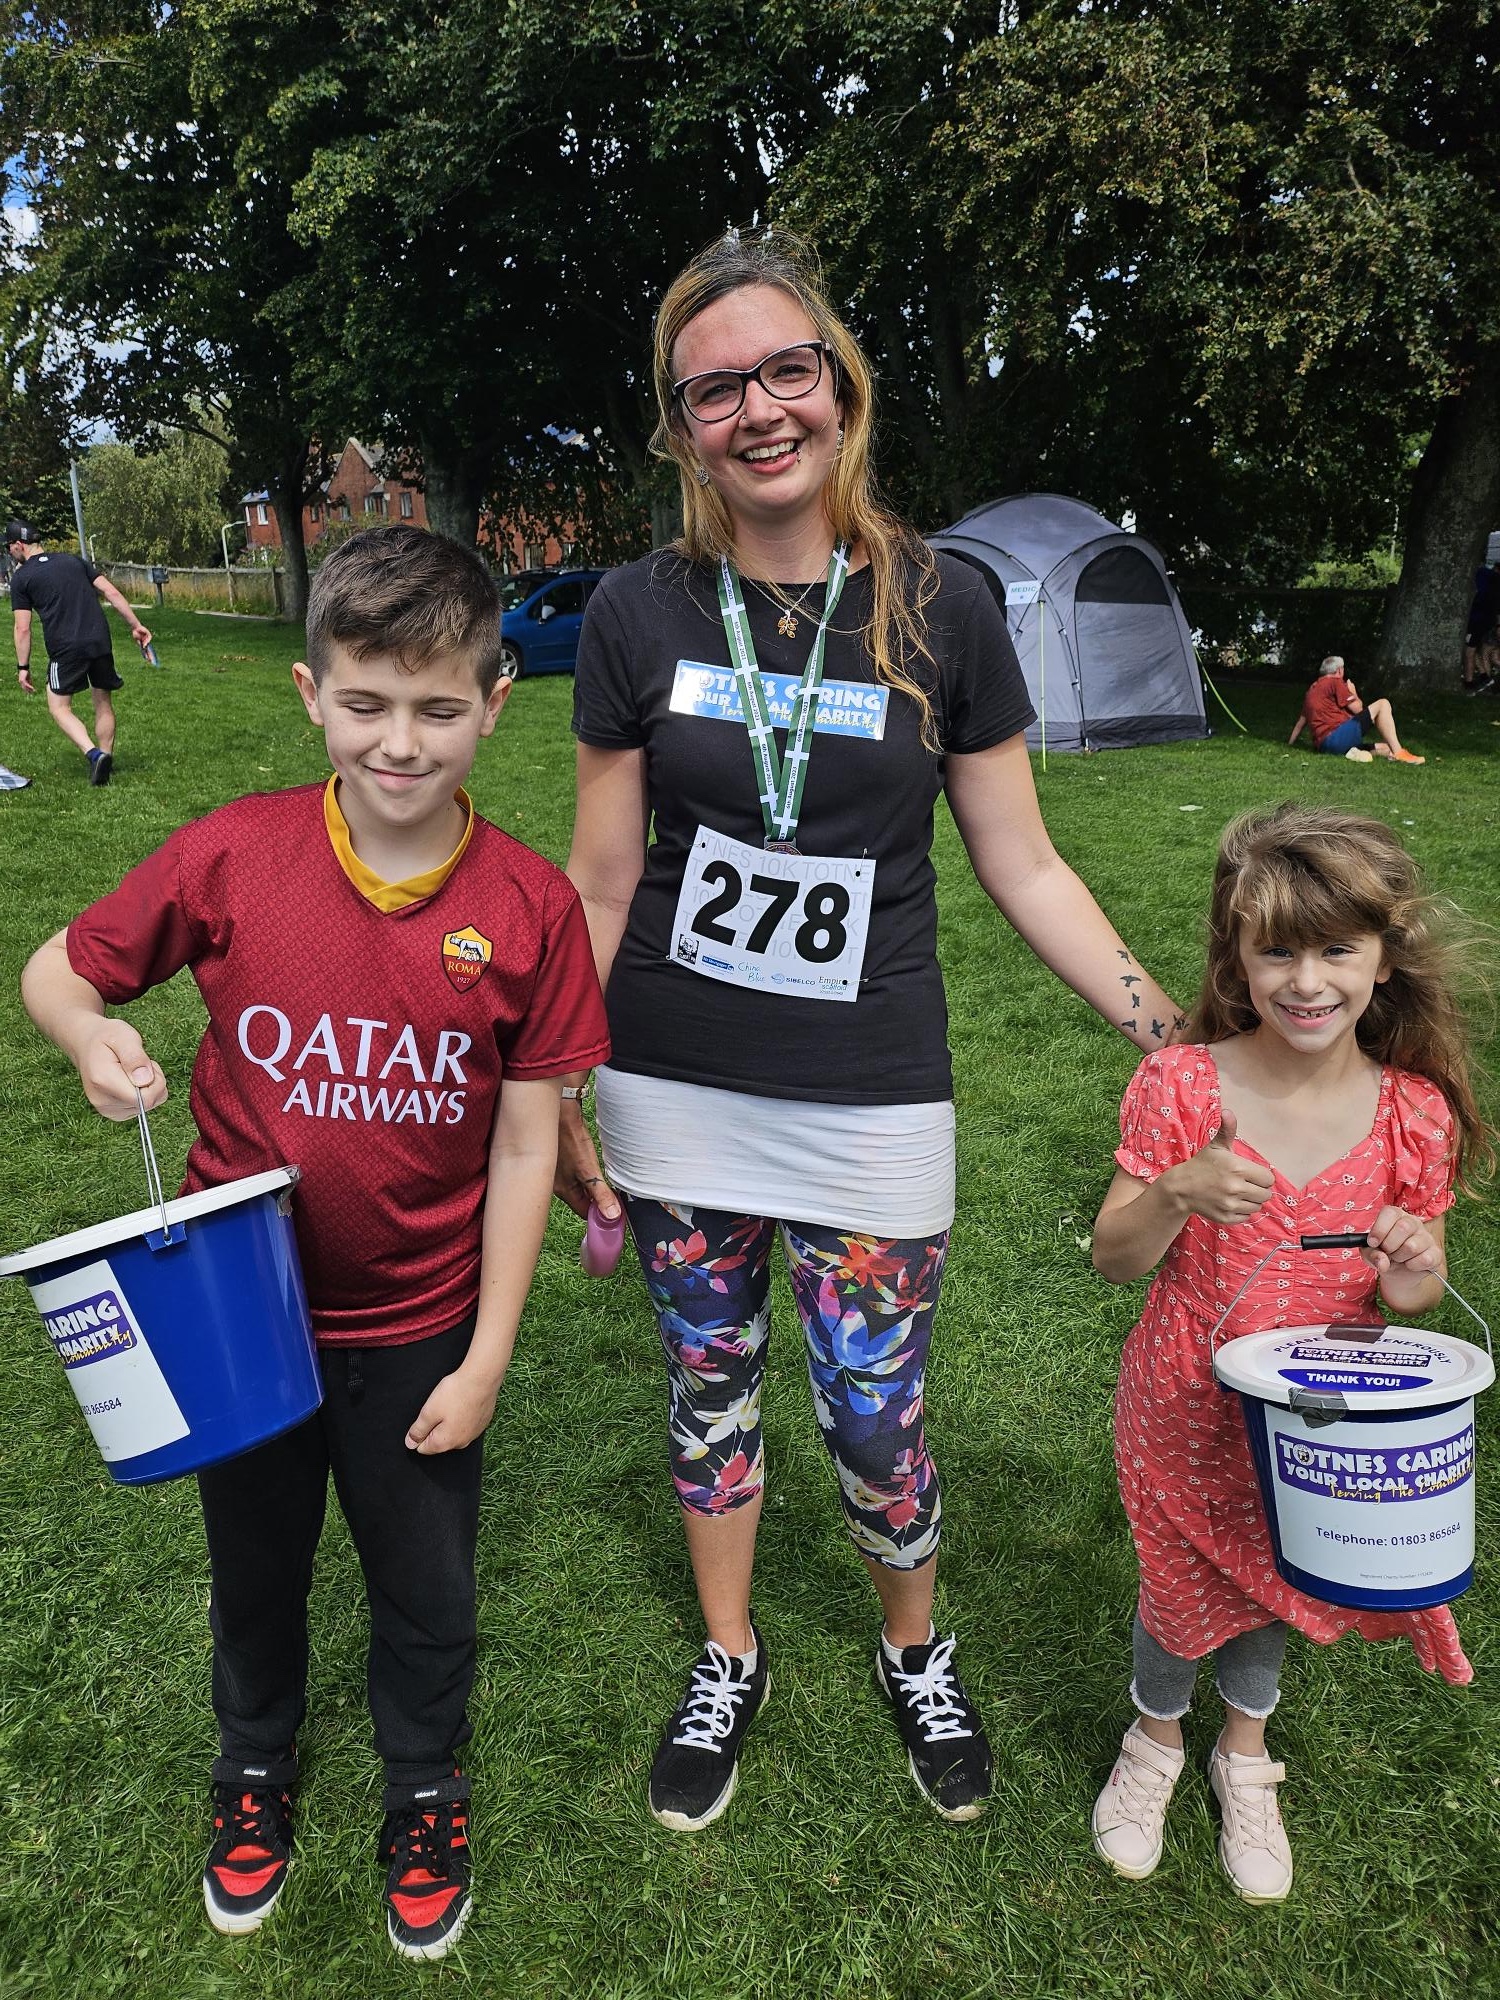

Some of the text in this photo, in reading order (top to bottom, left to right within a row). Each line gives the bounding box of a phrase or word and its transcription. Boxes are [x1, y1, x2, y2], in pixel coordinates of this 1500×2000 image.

[785, 683, 882, 711] CRING
[759, 855, 796, 879] 10K
[691, 860, 850, 963] 278
[447, 960, 482, 976] ROMA
[456, 976, 471, 985] 1927
[785, 977, 816, 985] SIBELCO
[819, 976, 847, 985] Empir
[237, 1005, 472, 1085] QATAR
[281, 1078, 467, 1125] AIRWAYS
[1274, 1336, 1452, 1364] PLEASE ENEROUSLY
[1298, 1347, 1429, 1361] TOTNES CARING
[1306, 1372, 1401, 1387] THANK YOU!
[91, 1397, 122, 1415] 865684
[1279, 1430, 1473, 1475] TOTNES CARING
[1284, 1453, 1473, 1493] YOUR LOCAL CHARITY
[1329, 1482, 1381, 1505] Serving
[1390, 1484, 1415, 1499] The
[1316, 1522, 1461, 1547] Telephone: 01803 865684
